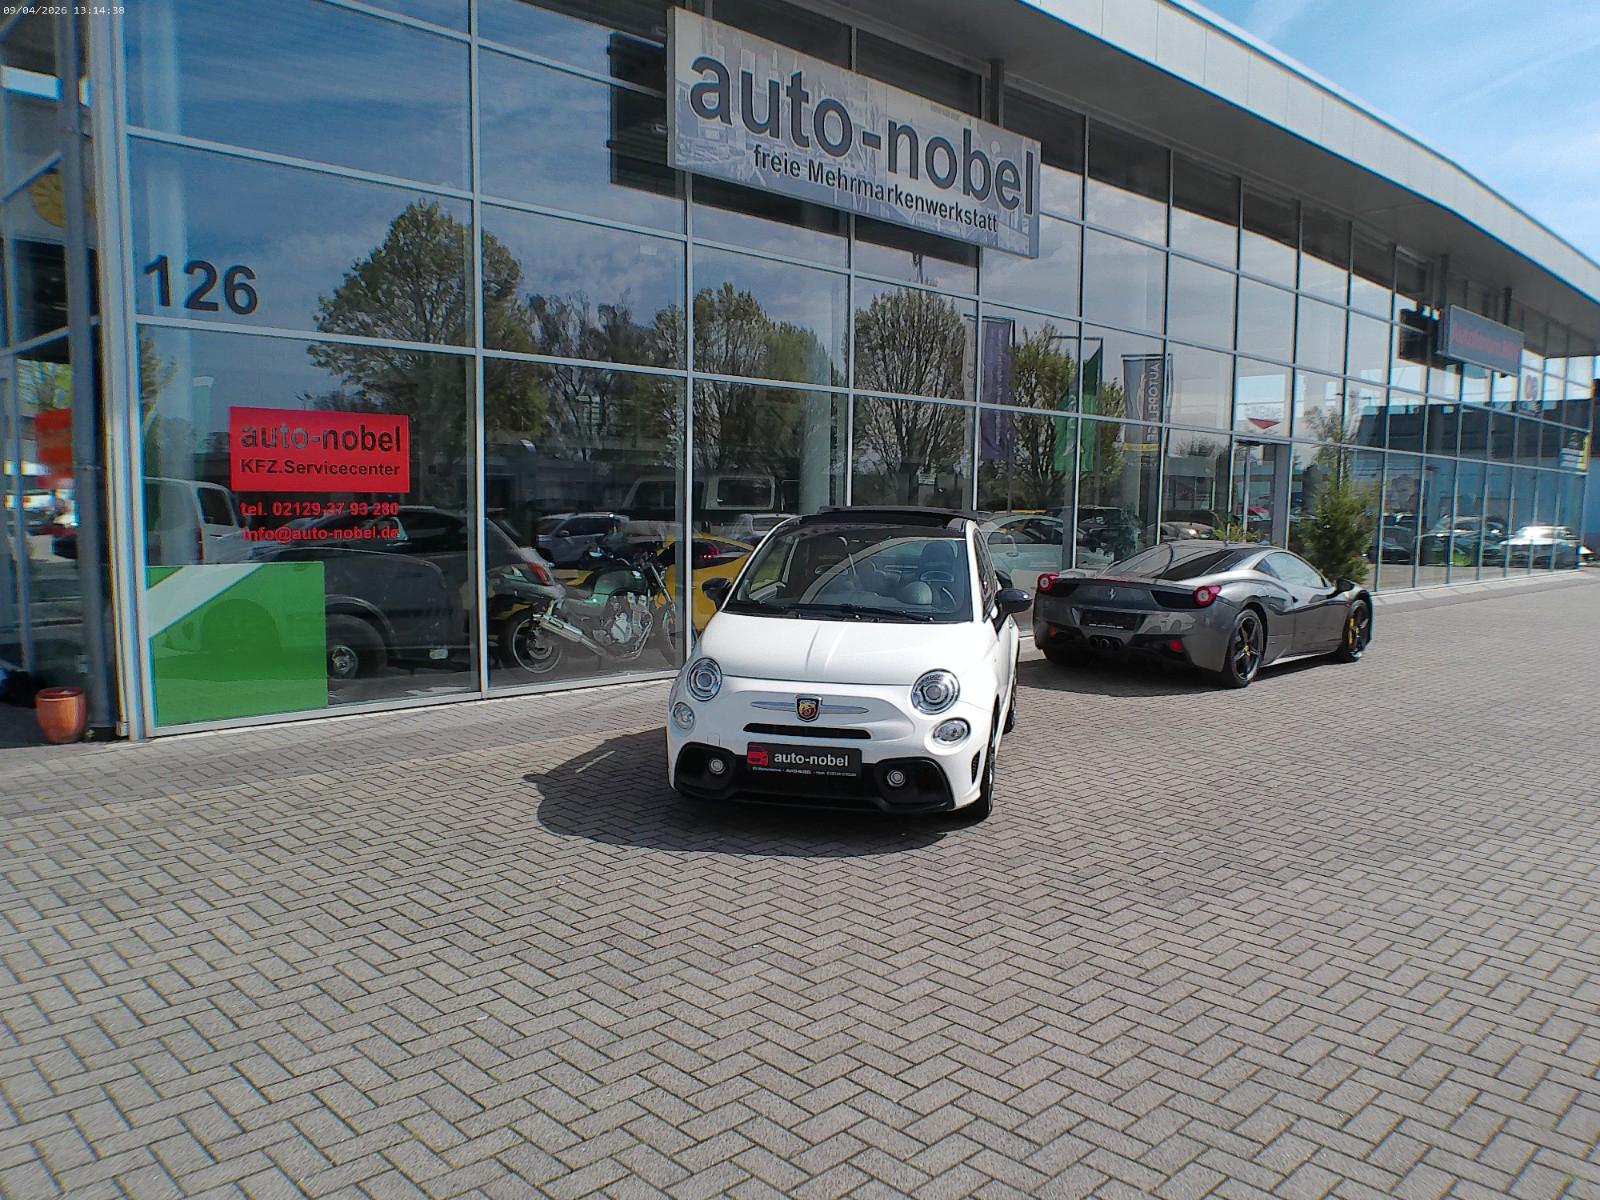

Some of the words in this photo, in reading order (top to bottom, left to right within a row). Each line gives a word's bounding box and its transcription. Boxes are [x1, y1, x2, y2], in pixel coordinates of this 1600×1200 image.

[689, 55, 1034, 216] auto-nobel
[753, 143, 801, 178] freie
[807, 158, 998, 233] Mehrmarkenwerkstatt
[144, 254, 258, 315] 126
[240, 423, 400, 452] auto-nobel
[240, 458, 400, 476] KFZ.Servicecenter
[240, 502, 267, 516] tel.
[272, 502, 345, 516] 02129-37
[350, 502, 369, 516] 93
[371, 502, 399, 516] 280
[241, 526, 399, 544] info@auto-nobel.de
[774, 752, 849, 767] auto-nobel
